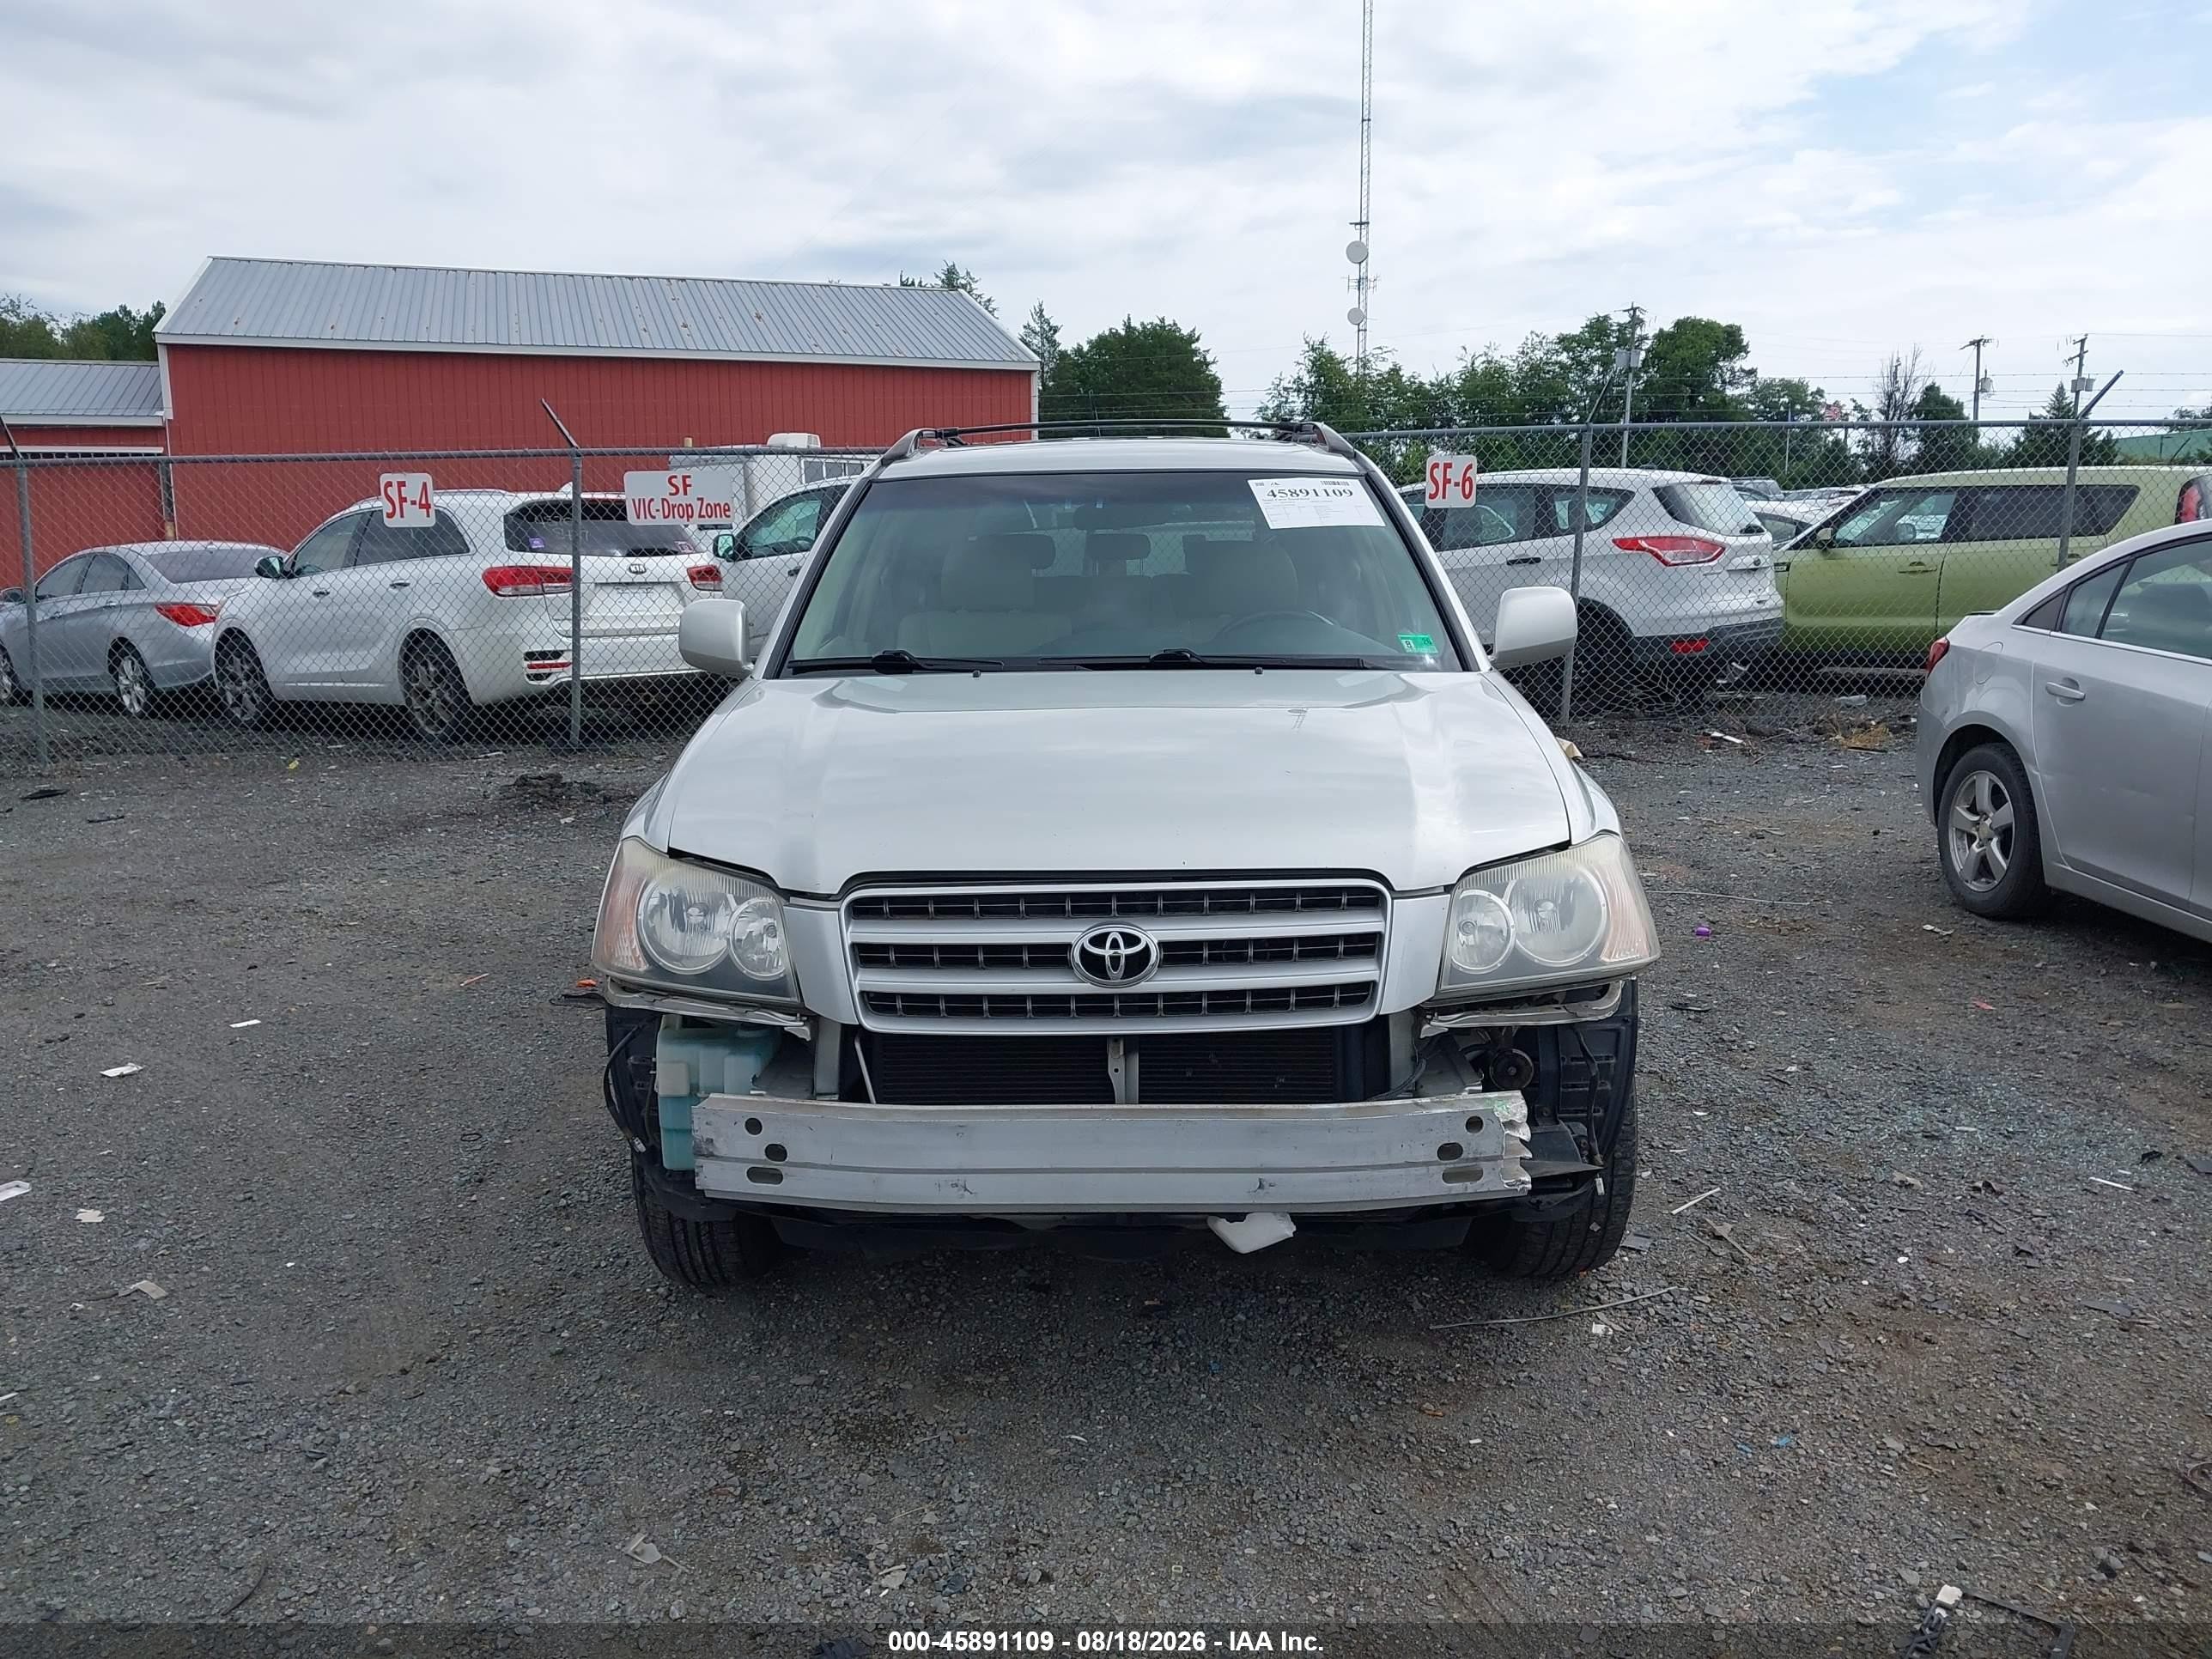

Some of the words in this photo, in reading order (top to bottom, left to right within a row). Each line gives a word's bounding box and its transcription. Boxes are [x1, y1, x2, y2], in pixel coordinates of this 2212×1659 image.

[667, 475, 692, 496] SF
[1267, 488, 1353, 498] 45891109
[1429, 462, 1474, 500] SF-6
[384, 480, 431, 519] SF-4
[631, 498, 695, 522] VIC-Drop
[696, 497, 732, 519] Zone
